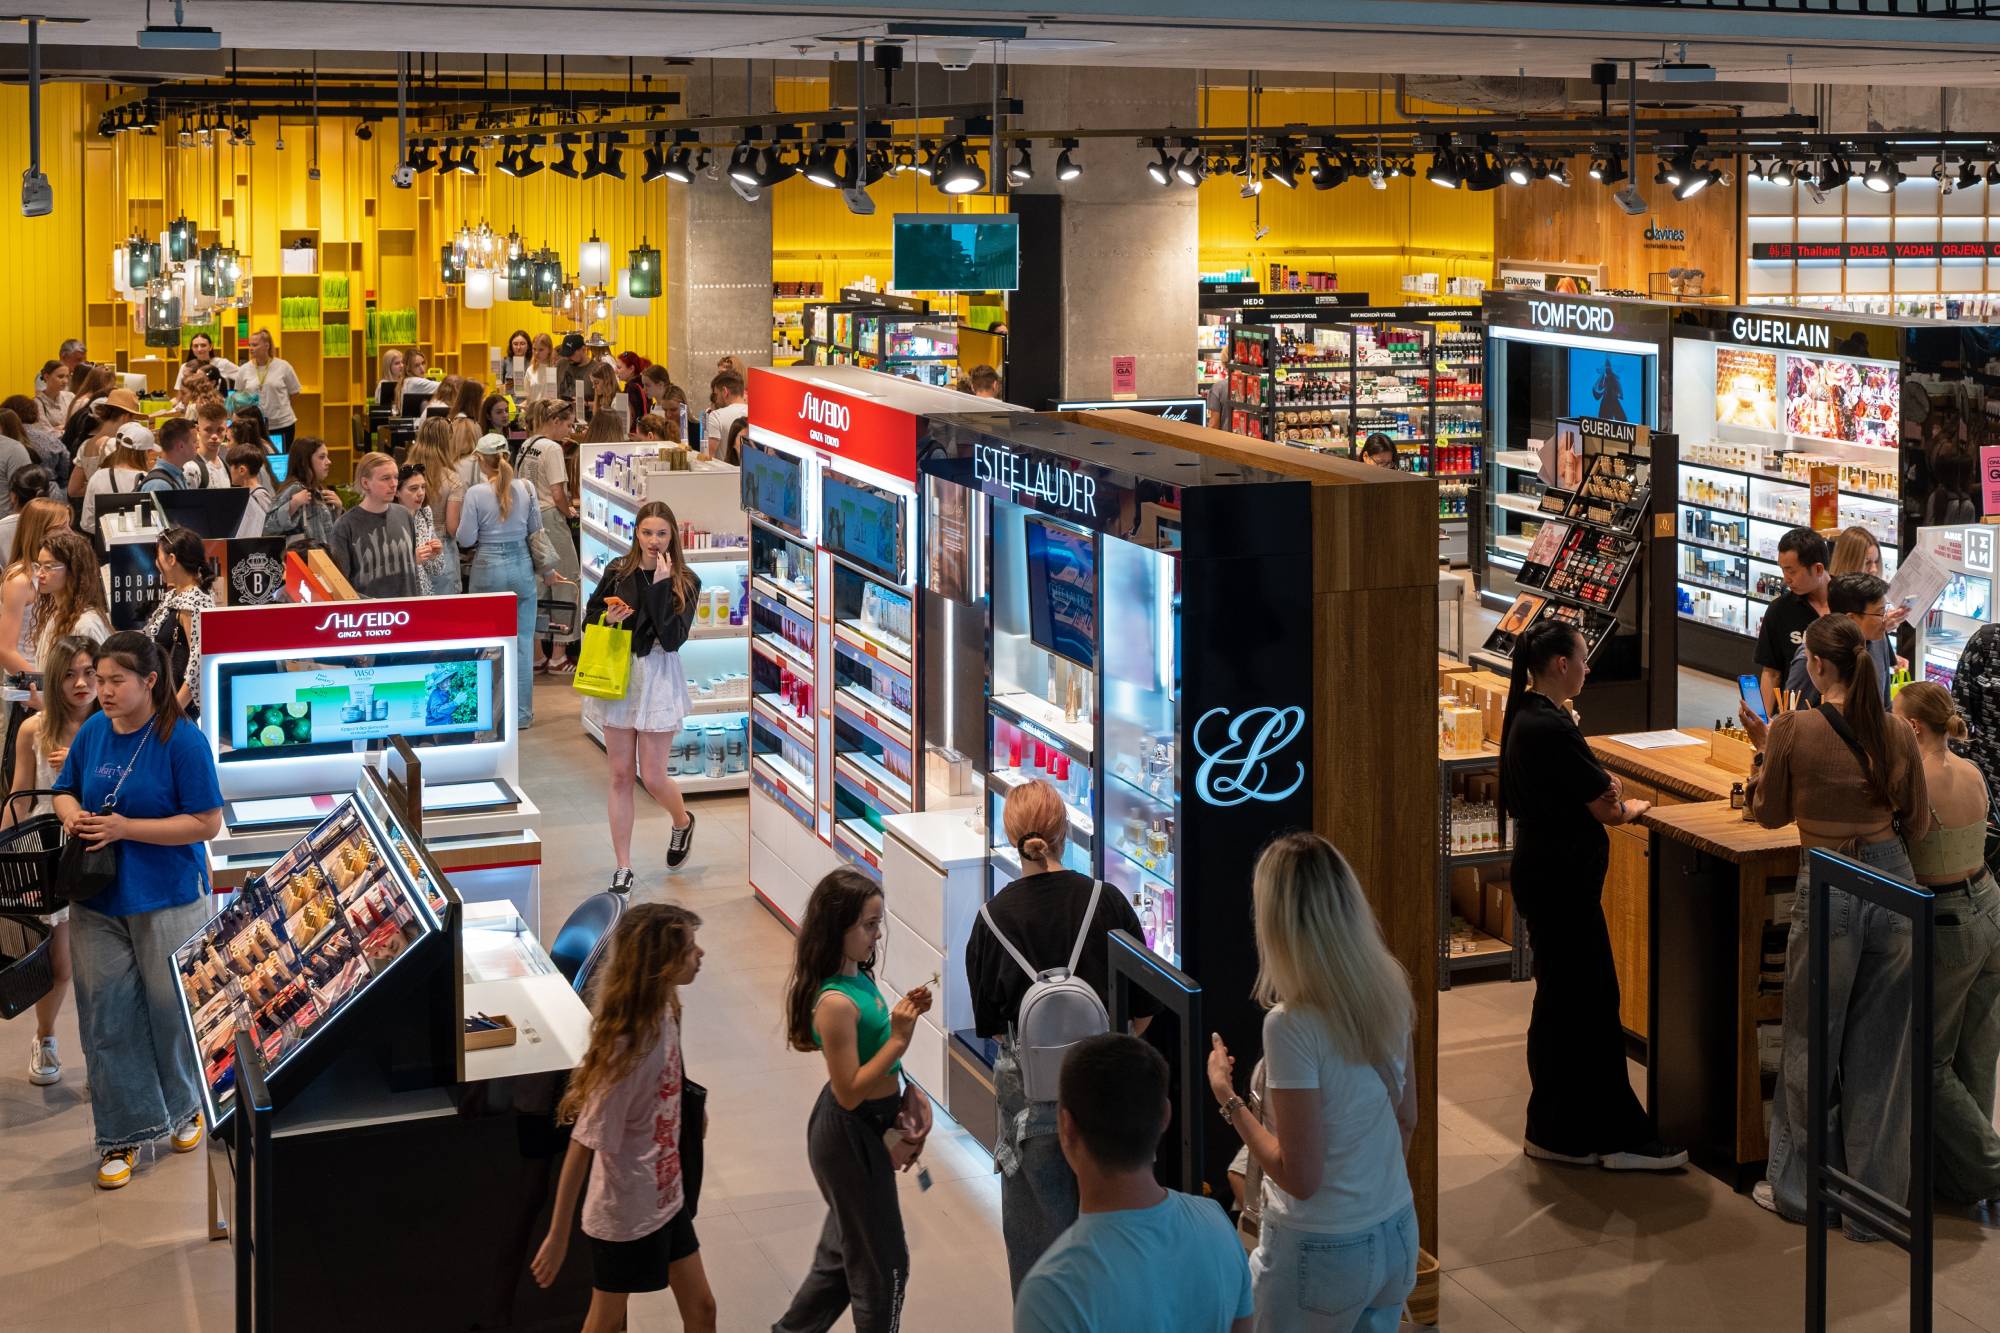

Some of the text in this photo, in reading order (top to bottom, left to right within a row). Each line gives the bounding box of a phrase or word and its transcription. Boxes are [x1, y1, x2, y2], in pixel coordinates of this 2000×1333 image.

[1644, 217, 1685, 241] davines
[1797, 245, 1840, 257] Thailand
[1850, 245, 1887, 256] DALBA
[1895, 244, 1933, 256] YADAH
[1942, 244, 1985, 256] ORJENA
[1528, 301, 1615, 332] TOM FORD
[1733, 317, 1829, 348] GUERLAIN
[798, 391, 850, 432] SHISEIDO
[809, 429, 824, 442] GINZA
[1581, 419, 1635, 441] GUERLAIN
[1025, 458, 1097, 517] LAUDER
[1813, 485, 1835, 497] SPF
[114, 574, 163, 588] BOBBI
[254, 573, 262, 595] B
[114, 588, 166, 603] BROWN
[315, 611, 409, 631] SHISEIDO
[365, 629, 391, 637] TOKYO
[354, 668, 375, 678] WASO
